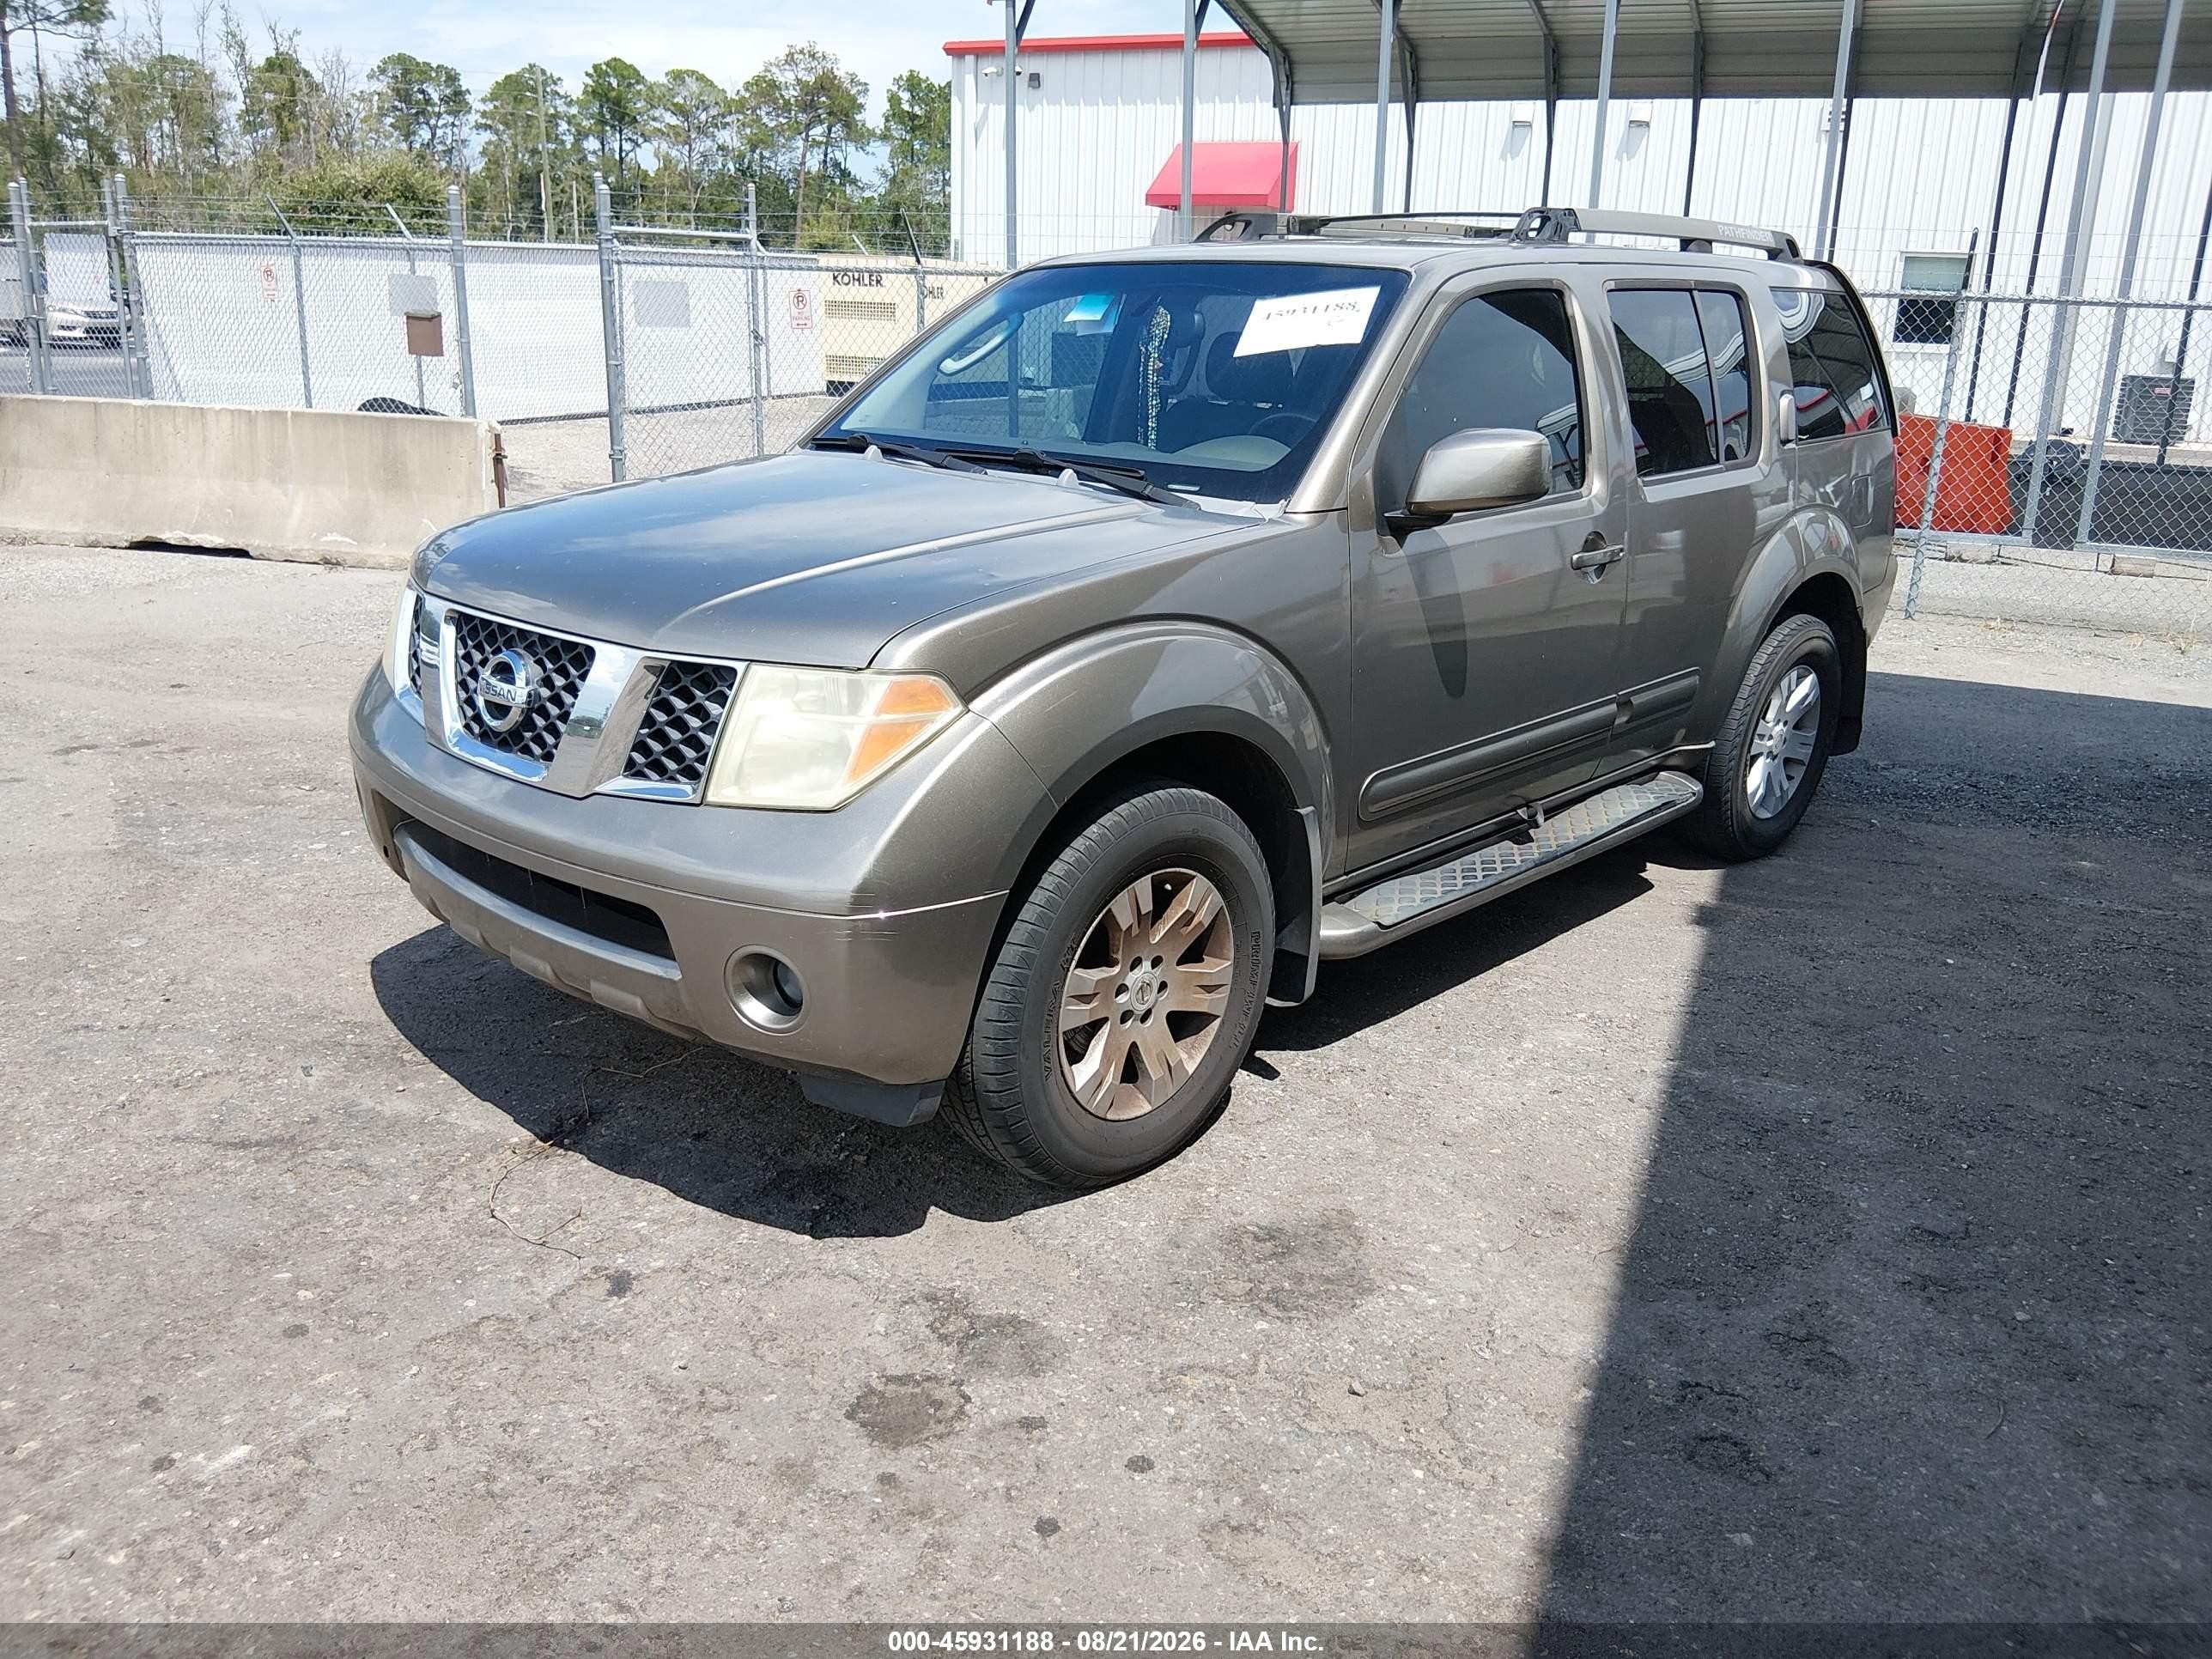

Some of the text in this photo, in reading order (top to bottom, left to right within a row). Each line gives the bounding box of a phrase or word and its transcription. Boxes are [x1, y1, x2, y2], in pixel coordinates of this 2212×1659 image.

[1717, 224, 1774, 242] PATHFINDER
[832, 272, 884, 288] KOHLER
[479, 679, 517, 702] NISSAN
